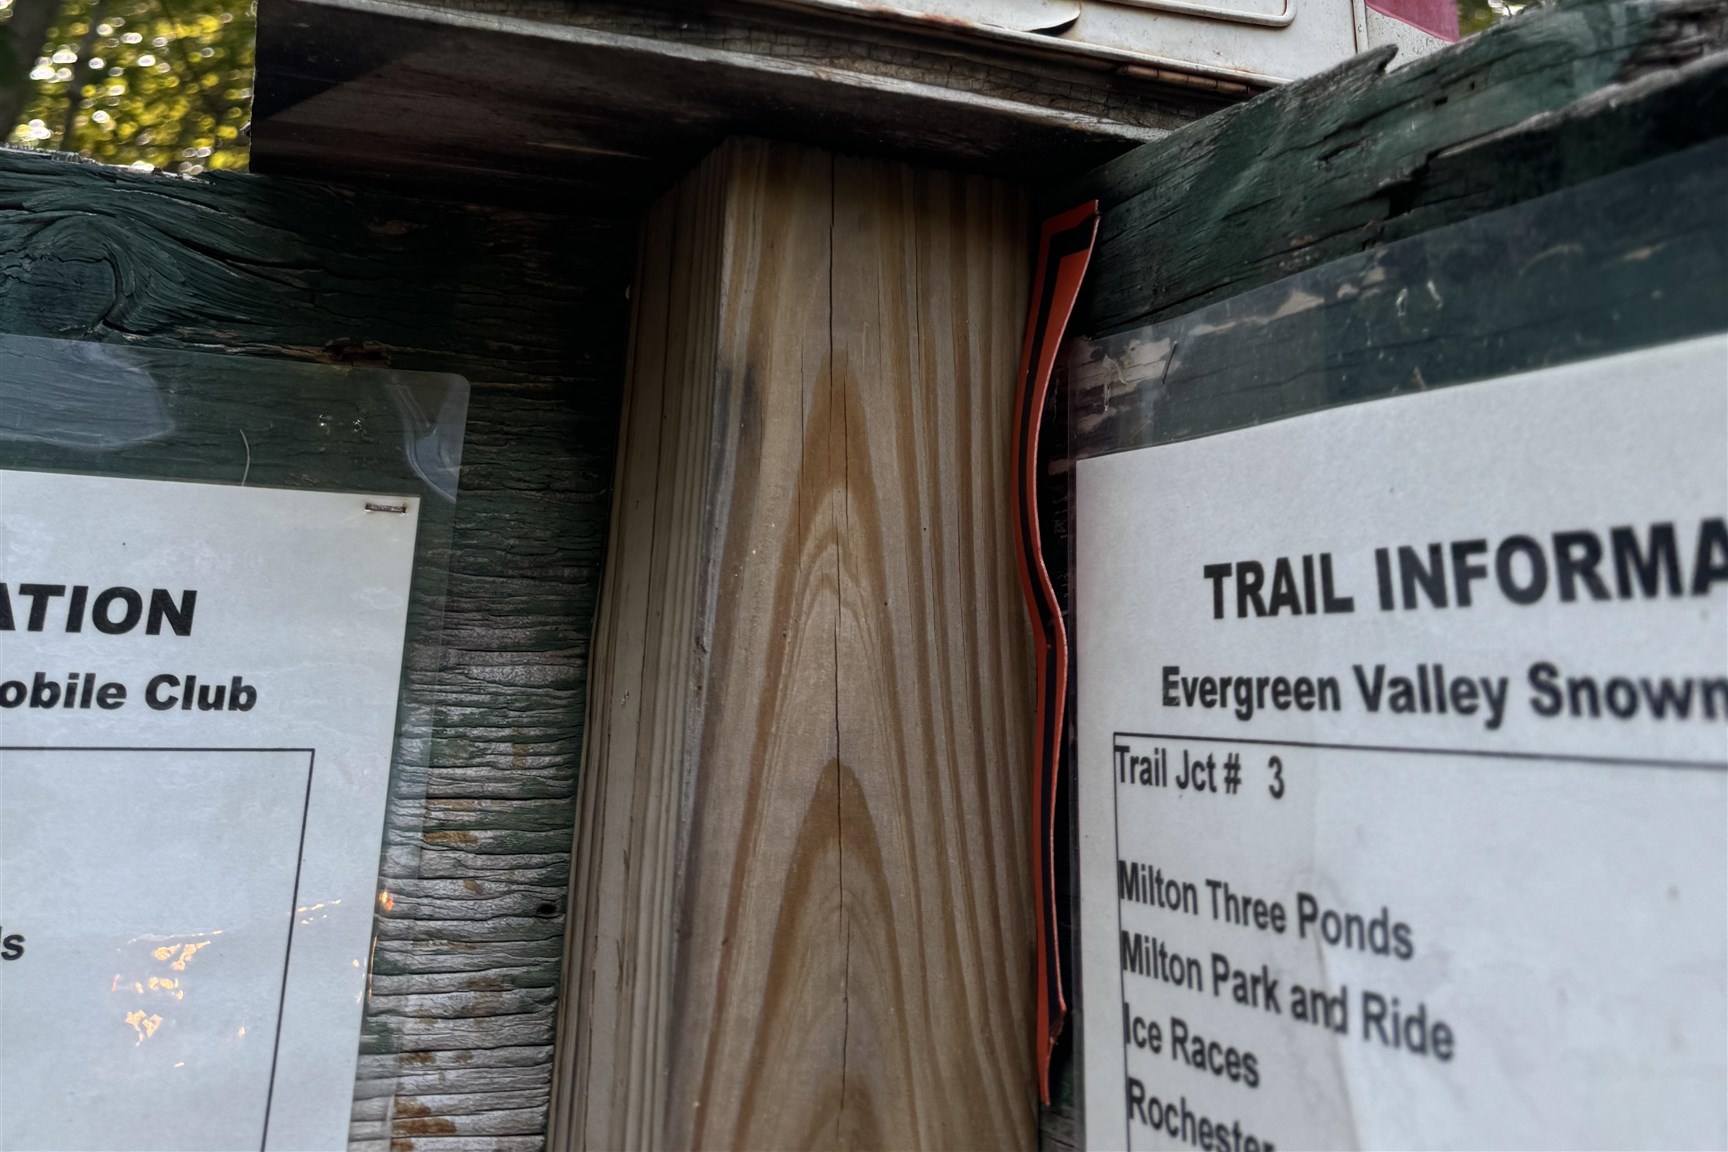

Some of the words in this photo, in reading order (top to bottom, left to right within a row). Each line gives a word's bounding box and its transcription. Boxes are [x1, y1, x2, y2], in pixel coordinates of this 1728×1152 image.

[1204, 552, 1355, 620] TRAIL
[1375, 517, 1728, 612] INFORMA
[0, 672, 127, 710] obile
[145, 673, 258, 711] Club
[1162, 665, 1342, 721] Evergreen
[1352, 663, 1509, 731] Valley
[1115, 745, 1167, 787] Trail
[1176, 749, 1217, 793] Jct
[1223, 752, 1242, 795] #
[1268, 755, 1285, 799] 3
[1119, 860, 1199, 915] Milton
[1206, 879, 1287, 935] Three
[1297, 892, 1414, 961] Ponds
[1121, 930, 1203, 993] Milton
[1211, 952, 1282, 1015] Park
[1291, 984, 1349, 1035] and
[1362, 991, 1456, 1062] Ride
[1124, 1002, 1162, 1054] Ice
[1171, 1016, 1260, 1088] Races
